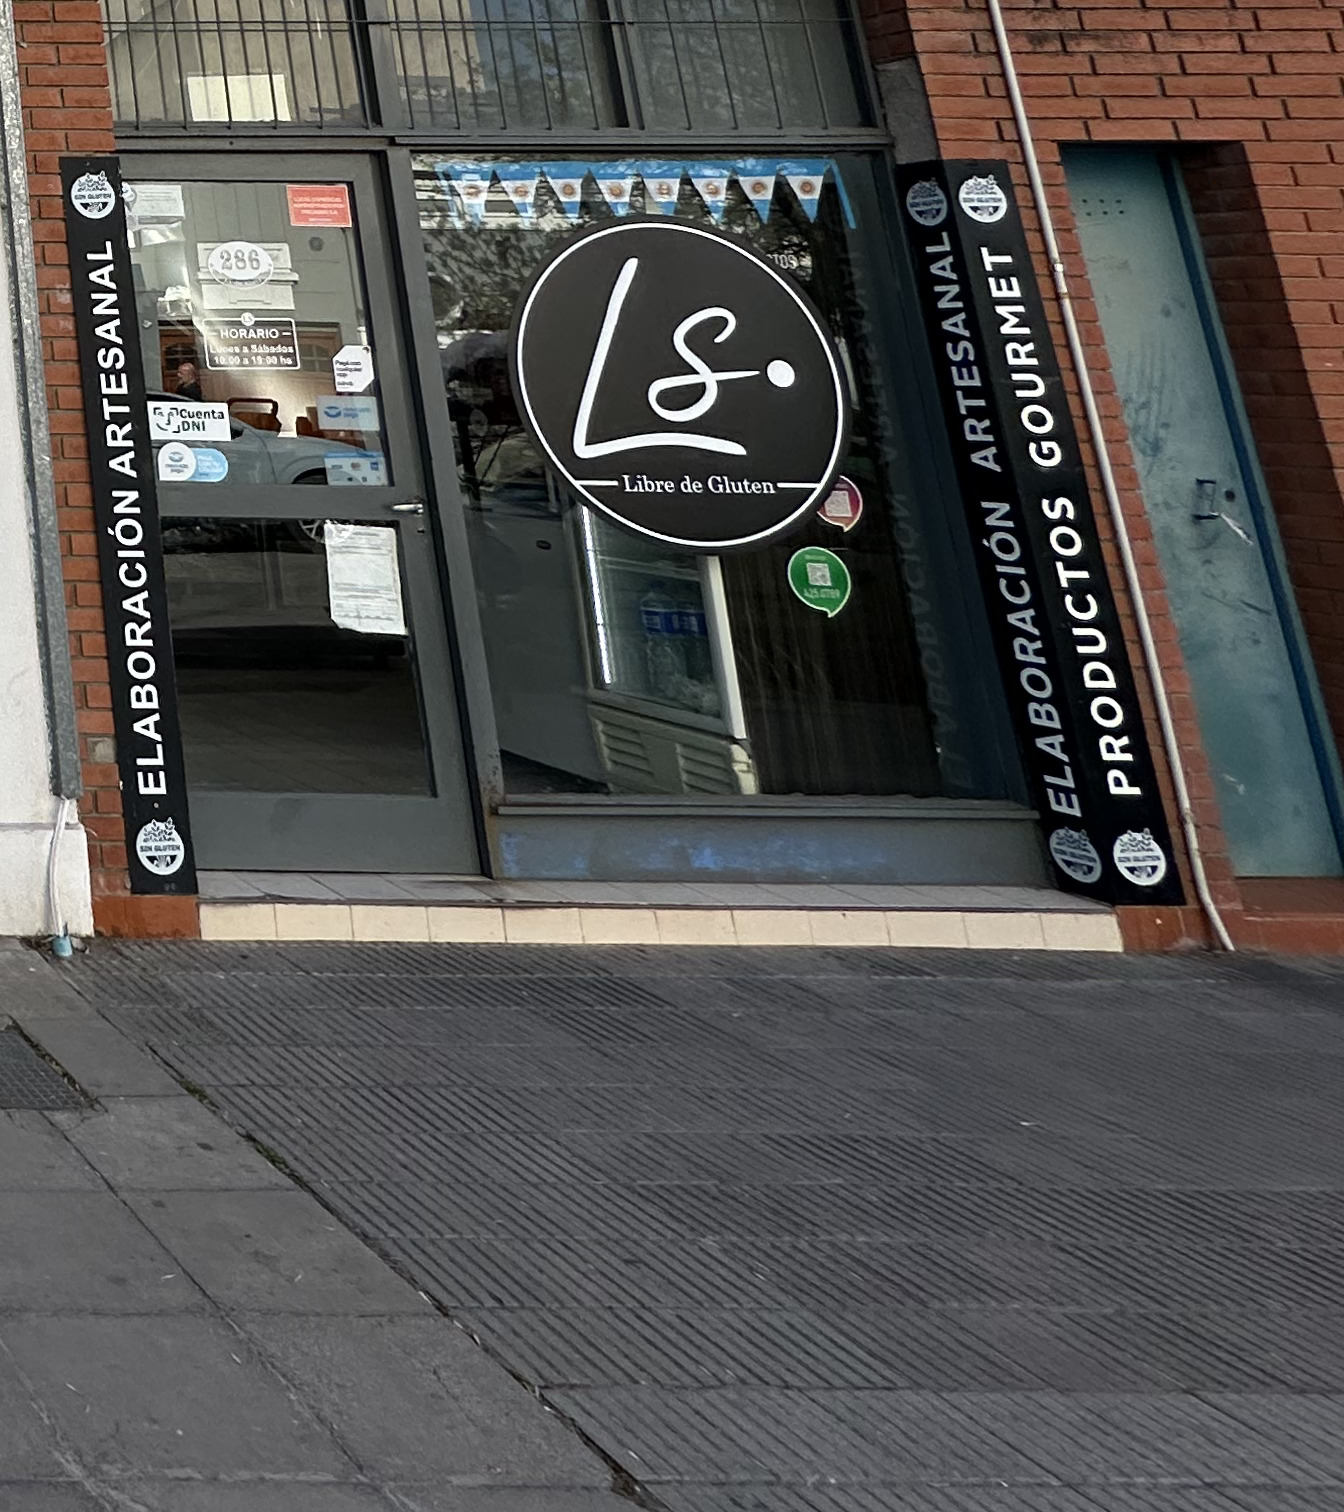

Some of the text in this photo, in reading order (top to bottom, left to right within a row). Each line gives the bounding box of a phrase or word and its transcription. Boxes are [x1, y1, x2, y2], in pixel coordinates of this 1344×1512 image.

[219, 249, 261, 270] 286
[220, 328, 279, 339] HORARIO
[925, 231, 1002, 472] ARTESANAL
[980, 246, 1062, 468] GOURMET
[179, 408, 225, 420] Cuenta
[181, 420, 206, 432] DNI
[86, 240, 167, 795] ELABORACIÓN ARTESANAL
[621, 474, 776, 494] Libre de Gluten
[980, 501, 1082, 818] ELABORACIÓN
[1041, 496, 1142, 795] PRODUCTOS
